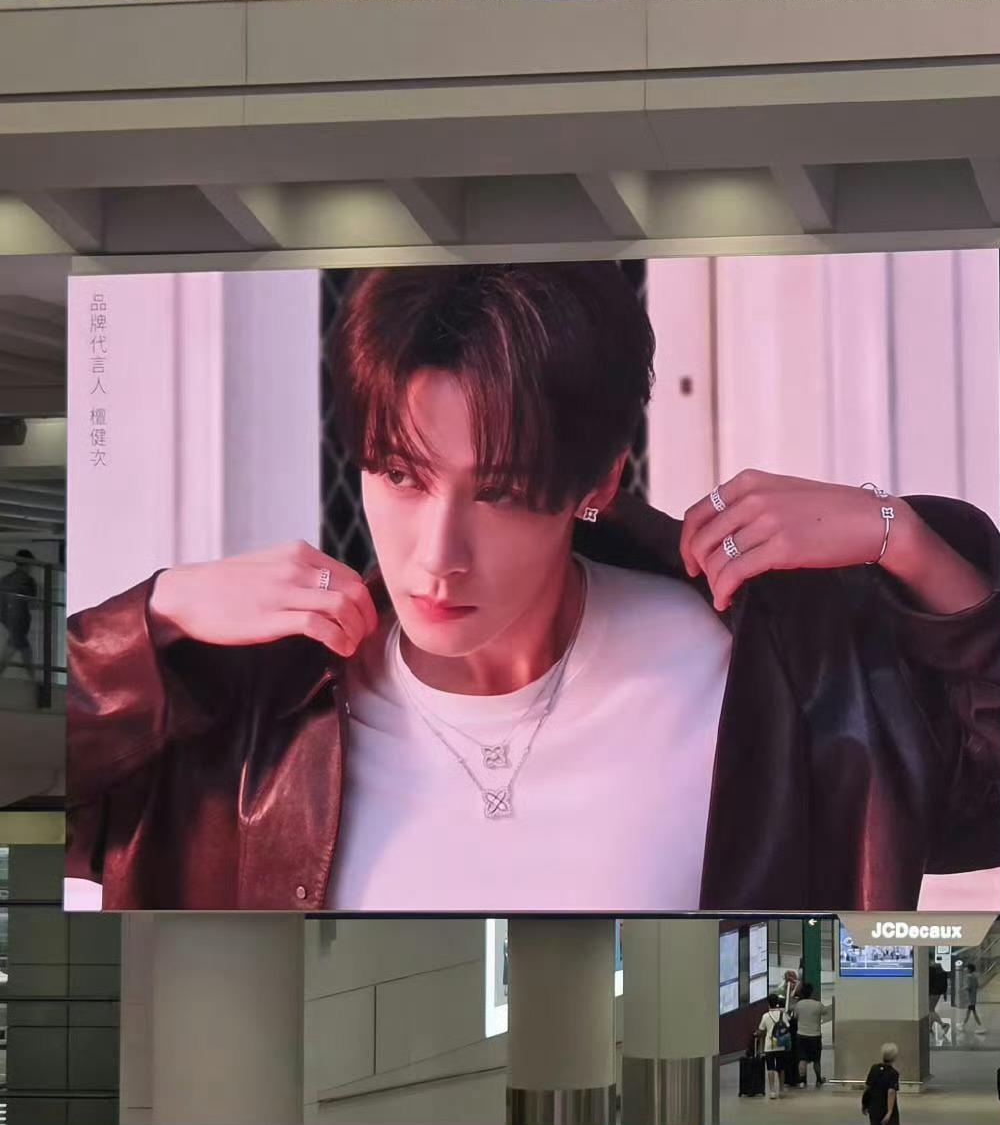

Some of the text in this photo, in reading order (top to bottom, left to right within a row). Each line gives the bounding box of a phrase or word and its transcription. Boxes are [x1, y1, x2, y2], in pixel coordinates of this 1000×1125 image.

[89, 293, 107, 395] 品牌代言人
[871, 921, 963, 939] JCDecaux
